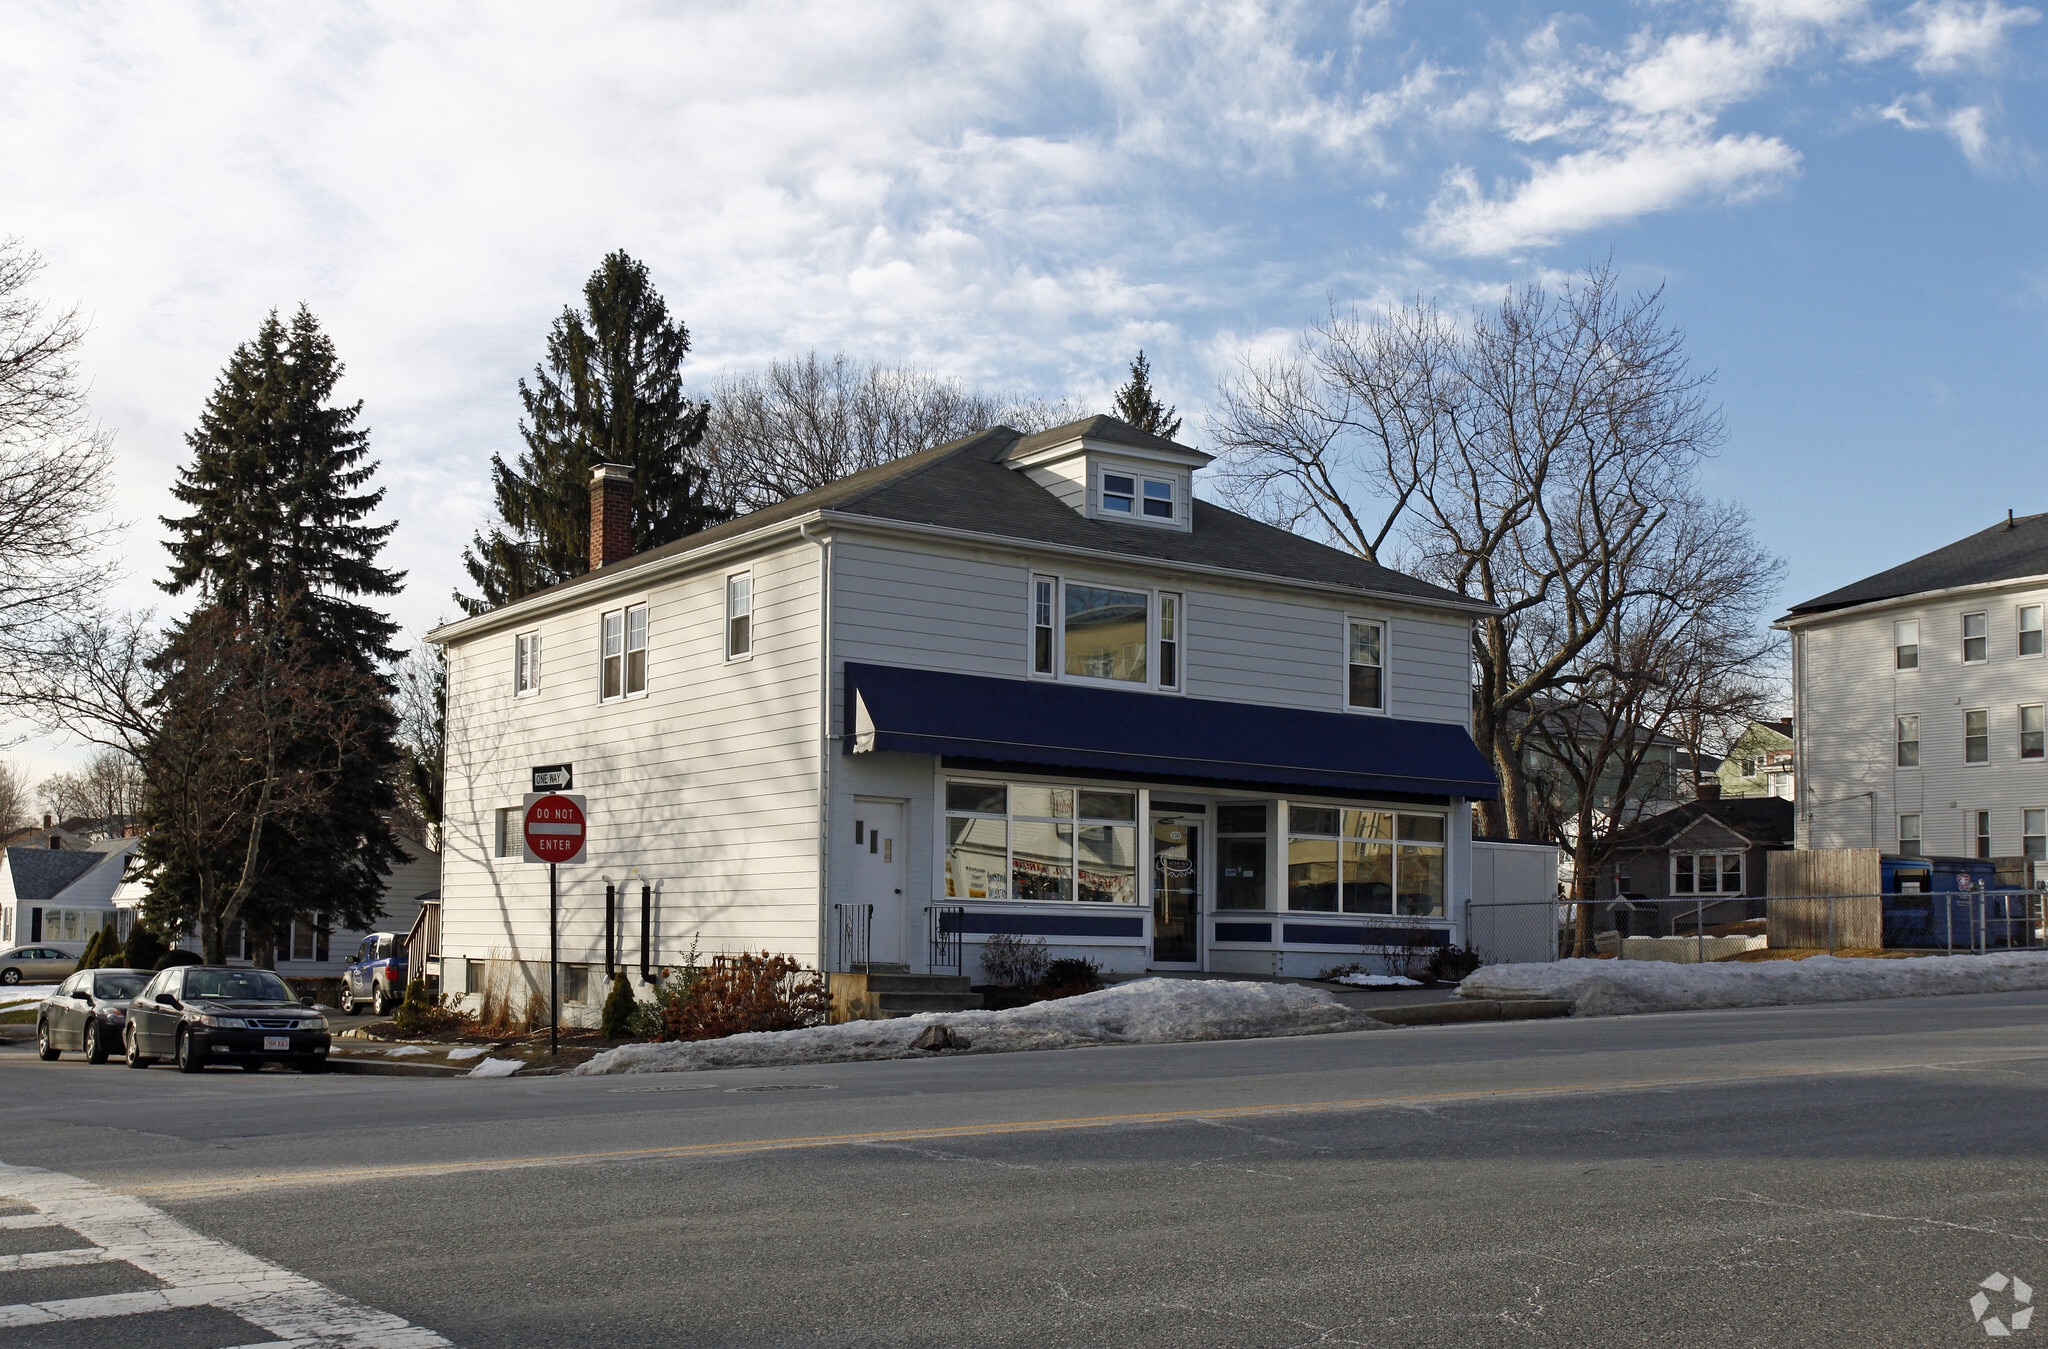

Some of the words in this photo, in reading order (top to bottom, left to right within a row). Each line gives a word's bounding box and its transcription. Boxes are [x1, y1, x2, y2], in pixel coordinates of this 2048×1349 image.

[536, 774, 548, 785] ONE
[549, 772, 561, 783] WAY
[536, 808, 550, 819] DO
[555, 808, 574, 820] NOT
[539, 839, 571, 851] ENTER
